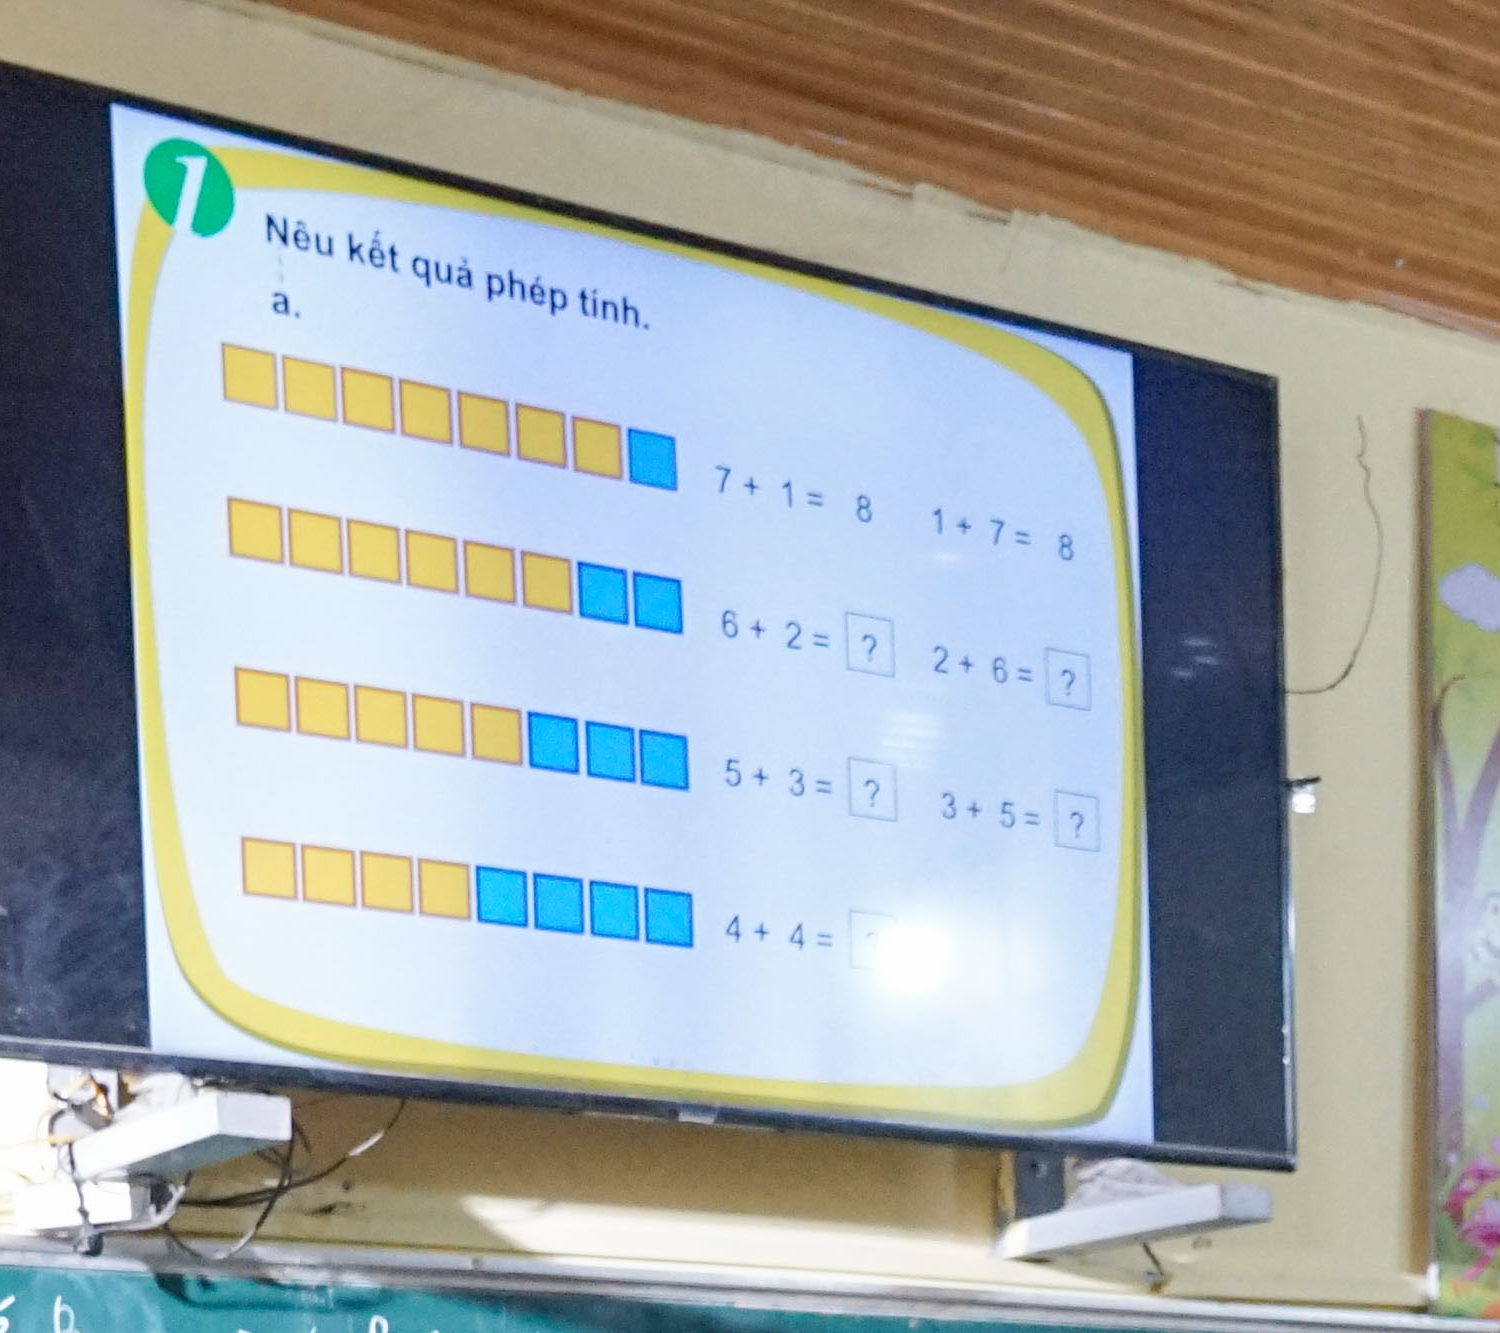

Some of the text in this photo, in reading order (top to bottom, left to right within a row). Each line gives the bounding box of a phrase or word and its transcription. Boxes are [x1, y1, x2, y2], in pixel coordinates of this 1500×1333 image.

[171, 155, 209, 237] 1
[267, 215, 651, 331] Nêu kết quả phép tính.
[273, 292, 302, 319] a.
[716, 466, 872, 522] 7 + 1 = 8
[934, 509, 1073, 560] 1 + 7 = 8
[722, 610, 876, 662] 6 + 2 = ?
[934, 646, 1075, 696] 2 + 6 = ?
[726, 759, 879, 806] 5 + 3 = ?
[943, 793, 1083, 838] 3 + 5 = ?
